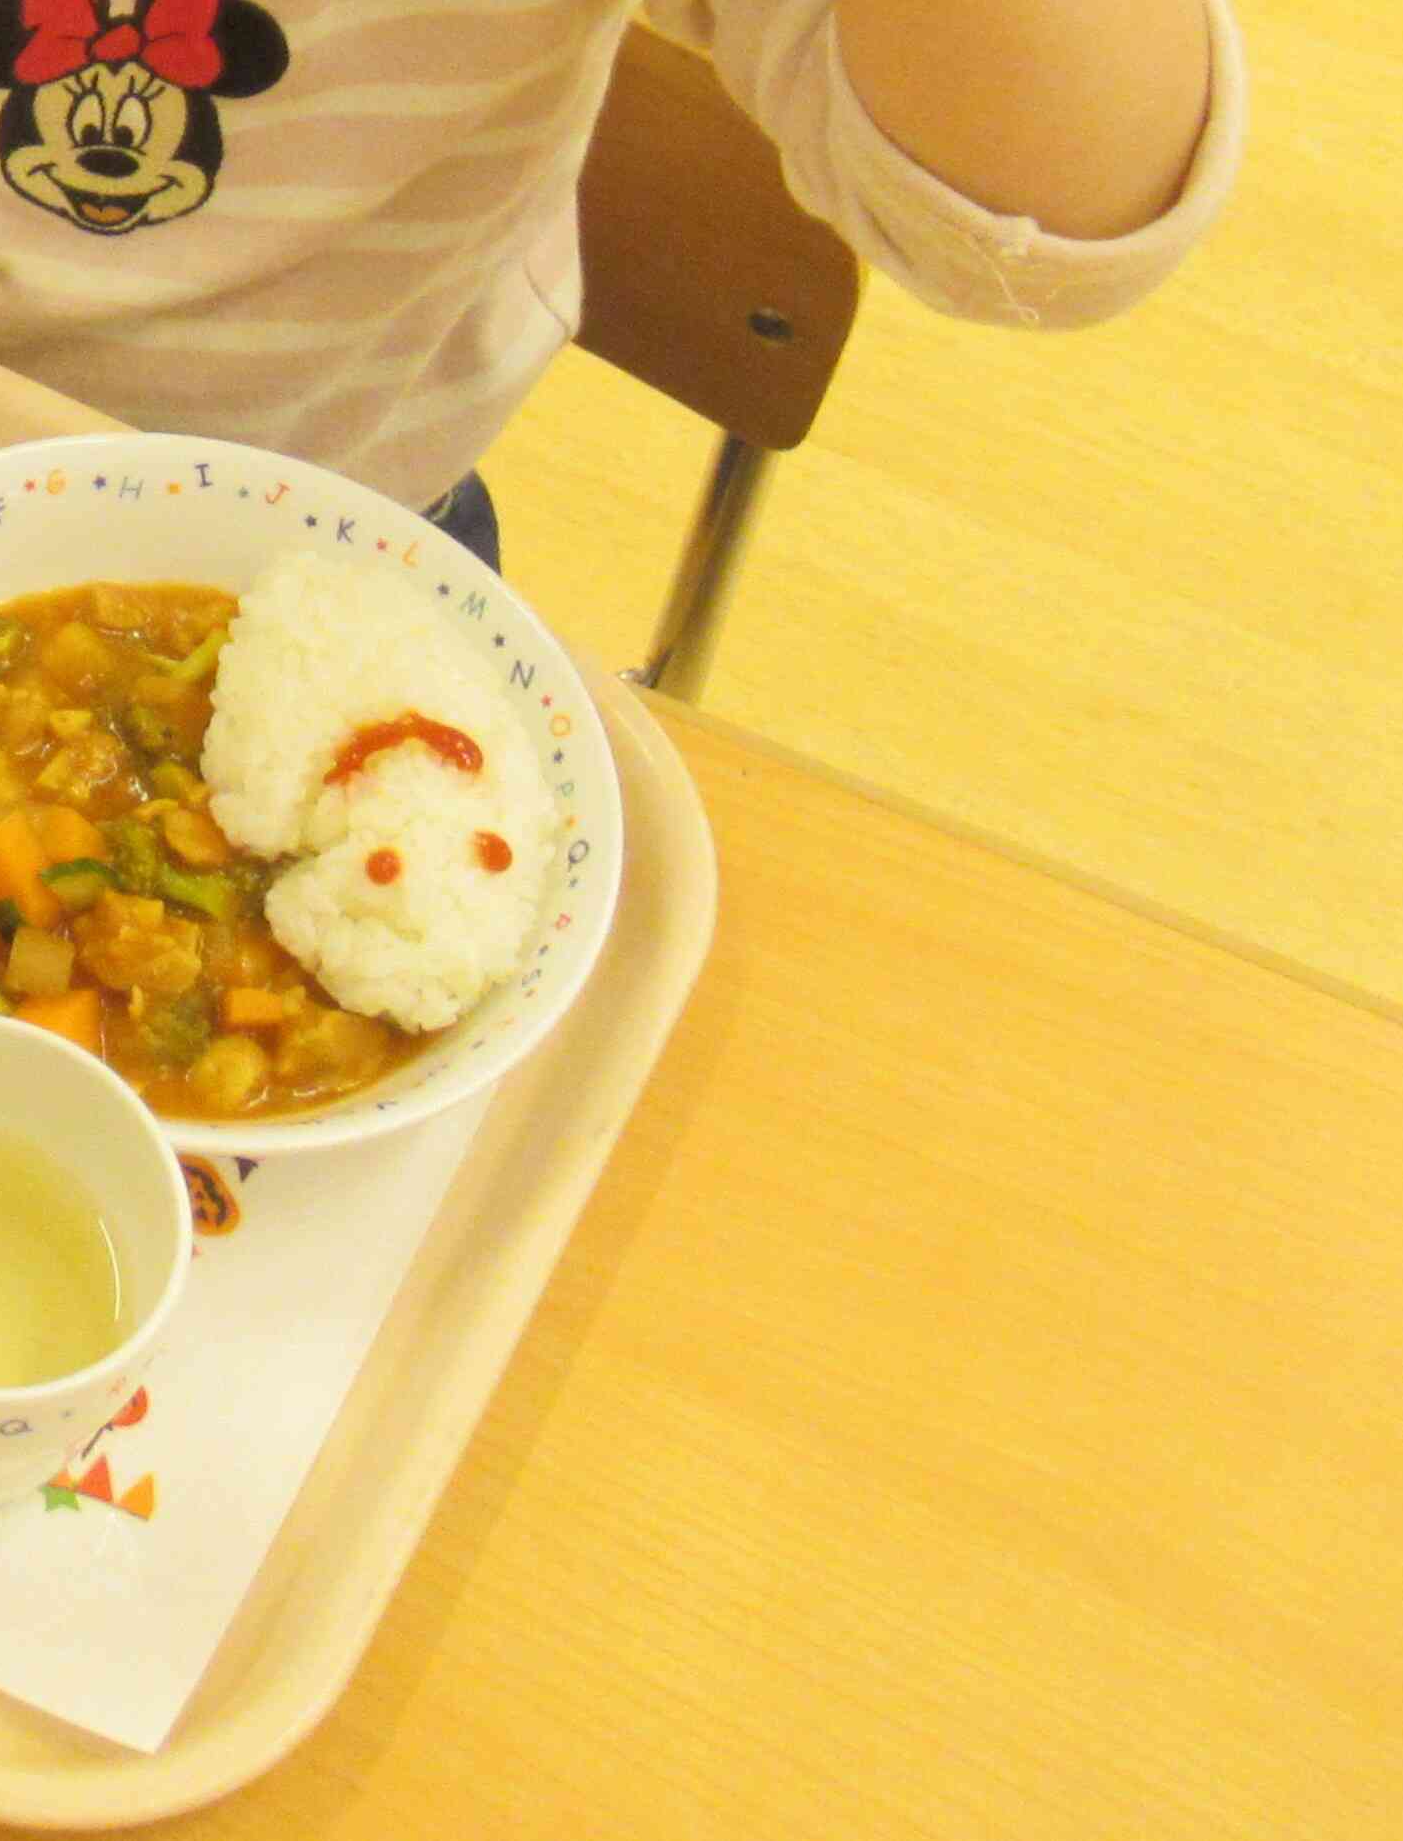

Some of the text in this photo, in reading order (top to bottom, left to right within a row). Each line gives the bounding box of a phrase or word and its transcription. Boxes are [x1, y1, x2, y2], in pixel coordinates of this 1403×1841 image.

[119, 476, 143, 500] H
[195, 463, 213, 487] I
[265, 482, 290, 505] J
[336, 517, 355, 543] K
[460, 591, 487, 620] M
[509, 660, 535, 689] N
[550, 713, 571, 737] O
[568, 839, 590, 872] Q
[0, 1418, 33, 1437] Q
